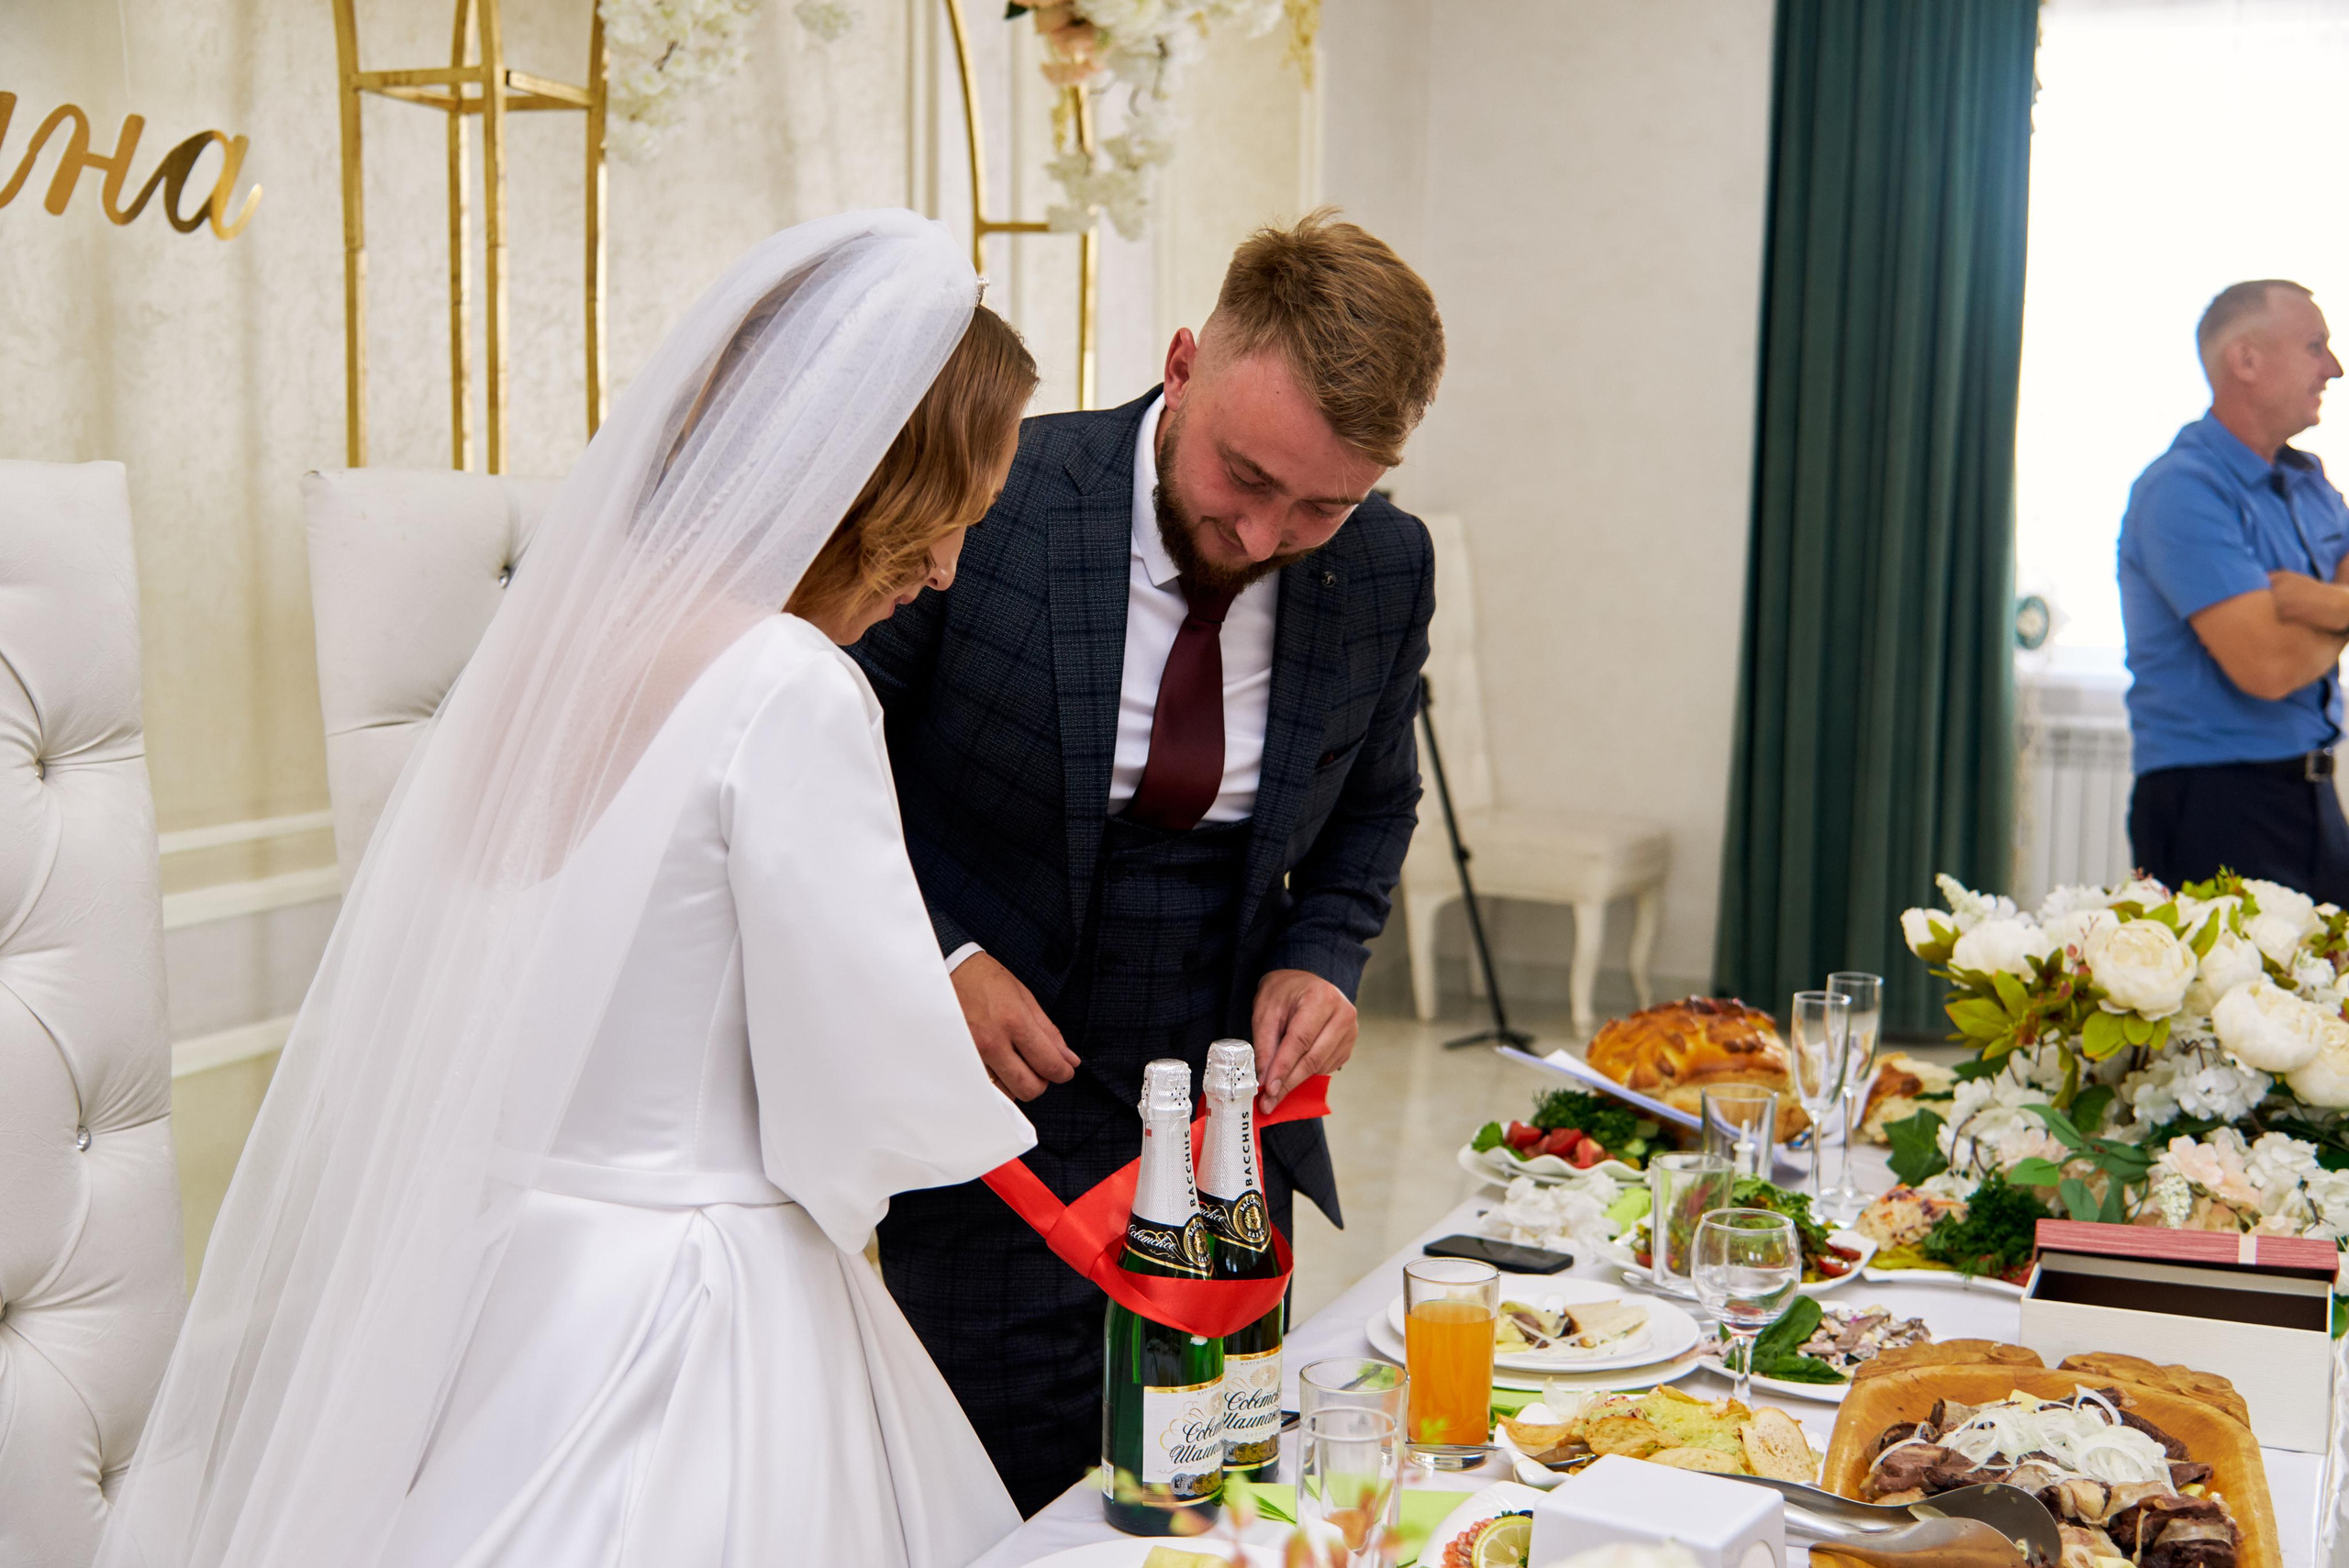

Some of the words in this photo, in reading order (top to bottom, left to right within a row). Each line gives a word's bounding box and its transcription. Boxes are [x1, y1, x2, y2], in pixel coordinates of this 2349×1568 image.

[1184, 1129, 1197, 1207] BACCHUS
[1241, 1110, 1252, 1187] BACCHUS
[1127, 1223, 1178, 1251] Советское
